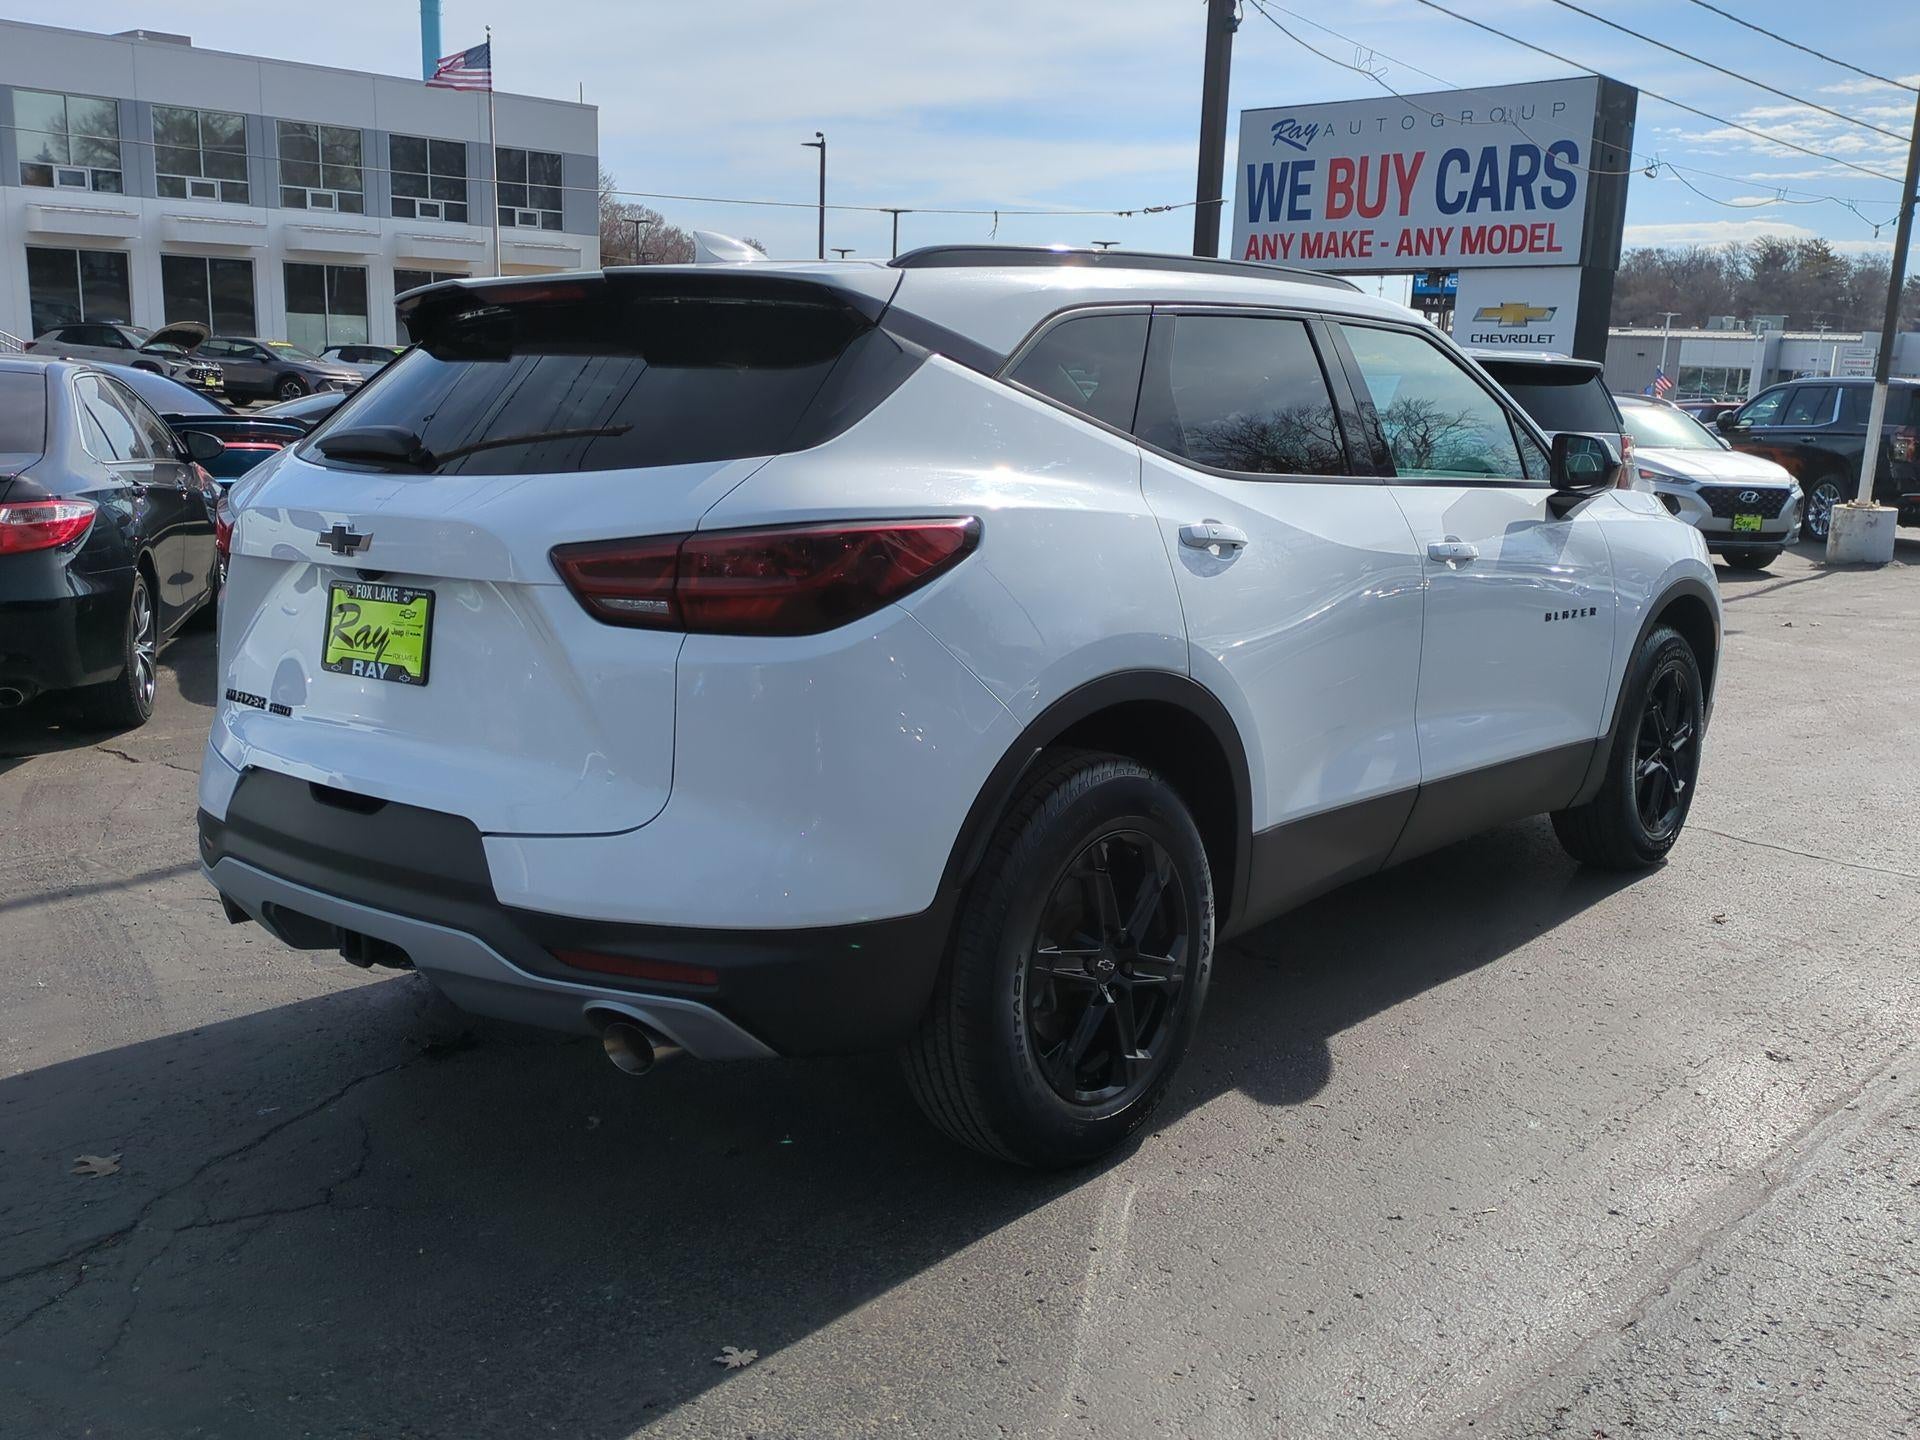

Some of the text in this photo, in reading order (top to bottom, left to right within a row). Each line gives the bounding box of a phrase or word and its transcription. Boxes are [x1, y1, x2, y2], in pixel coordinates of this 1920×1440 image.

[1271, 102, 1567, 152] Ray AUTOGROUP
[1247, 139, 1580, 224] WE BUY CARS
[1244, 232, 1296, 261] ANY
[1300, 229, 1375, 259] MAKE
[1395, 226, 1455, 257] ANY
[1459, 222, 1563, 255] MODEL
[1470, 333, 1556, 344] CHEVROLET
[356, 584, 399, 602] FOX LAKE
[1544, 606, 1597, 623] BLAZER
[329, 602, 391, 662] Ray
[351, 660, 390, 680] RAY
